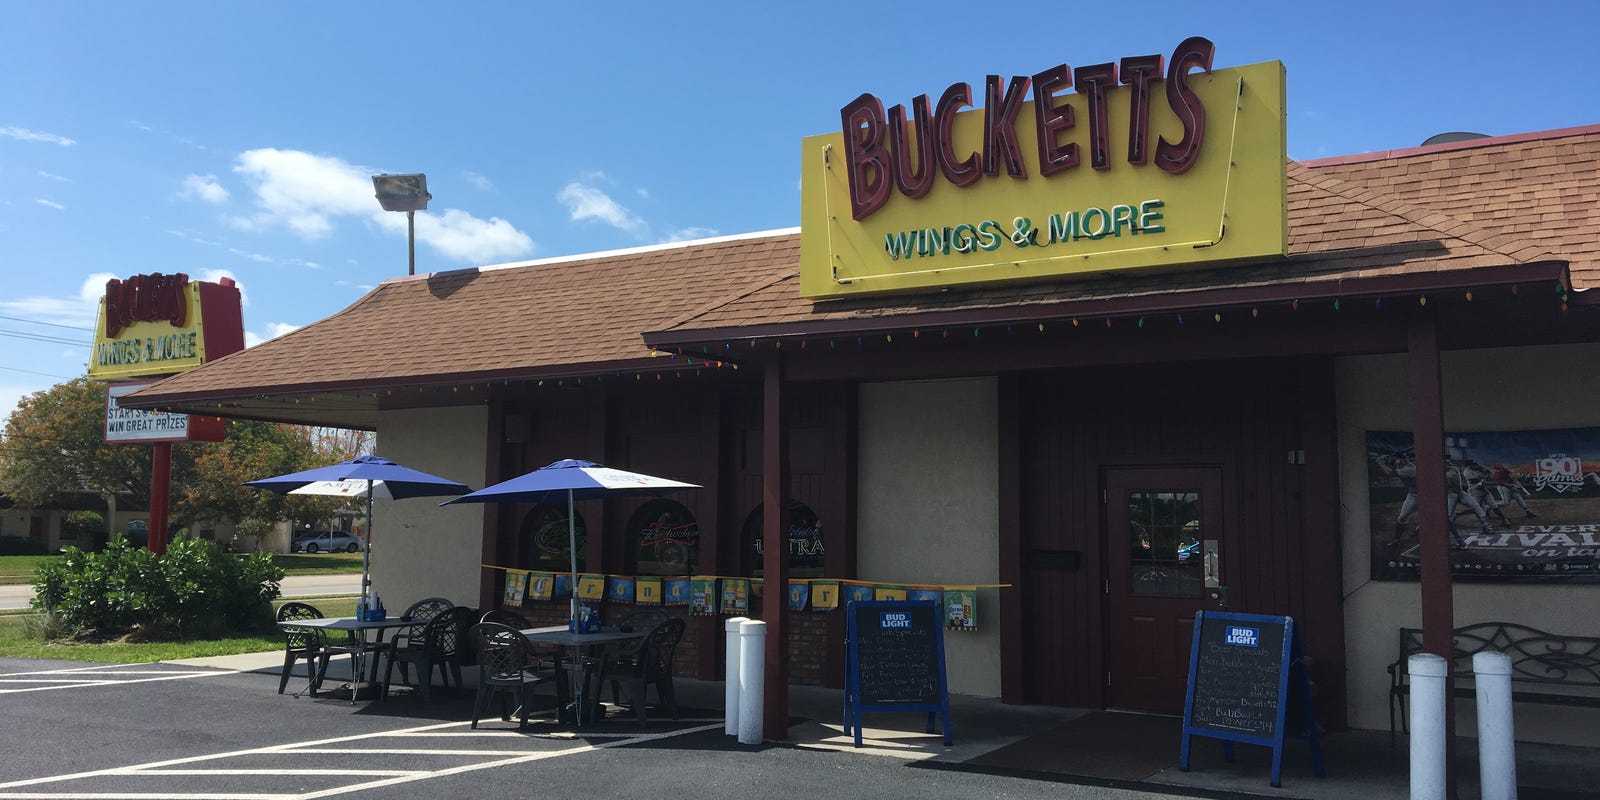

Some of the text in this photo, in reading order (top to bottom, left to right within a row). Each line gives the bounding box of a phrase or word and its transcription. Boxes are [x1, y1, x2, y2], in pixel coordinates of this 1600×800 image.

[841, 36, 1215, 221] BUCKETTS
[885, 199, 1166, 261] WINGS & MORE
[98, 338, 141, 366] WINGS
[154, 331, 197, 361] MORE
[108, 416, 186, 433] WIN GREAT PRIZES
[1540, 457, 1578, 476] 90
[1520, 548, 1563, 557] on
[885, 613, 906, 621] BUD
[882, 620, 910, 628] LIGHT
[1232, 628, 1254, 637] BUD
[1227, 635, 1257, 645] LIGHT
